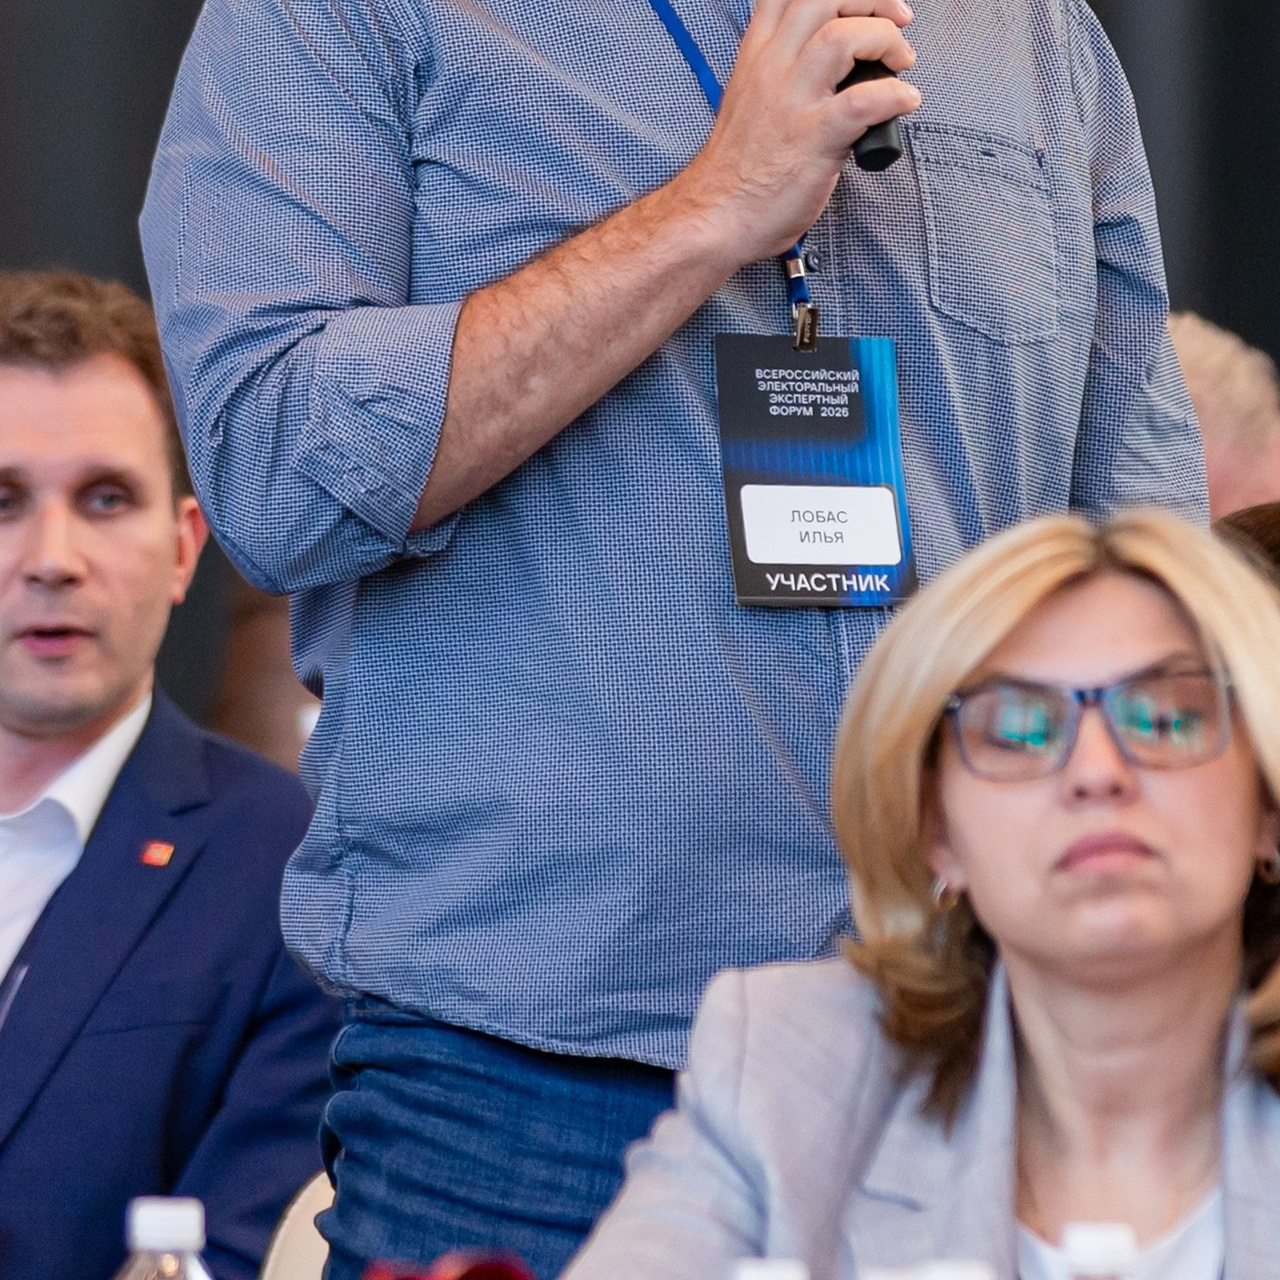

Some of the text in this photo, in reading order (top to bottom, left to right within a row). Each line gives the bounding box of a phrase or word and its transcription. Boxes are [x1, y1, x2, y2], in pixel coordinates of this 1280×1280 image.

[755, 368, 860, 381] ВСЕРОССИЙСКИЙ
[757, 381, 859, 393] ЭЛЕКТОРАЛЬНЫЙ
[769, 393, 849, 405] ЭКСПЕРТНЫЙ
[769, 405, 813, 416] ФОРУМ
[791, 510, 848, 524] ЛОБАС
[799, 531, 844, 544] ИЛЬЯ
[765, 572, 890, 592] УЧАСТНИК
